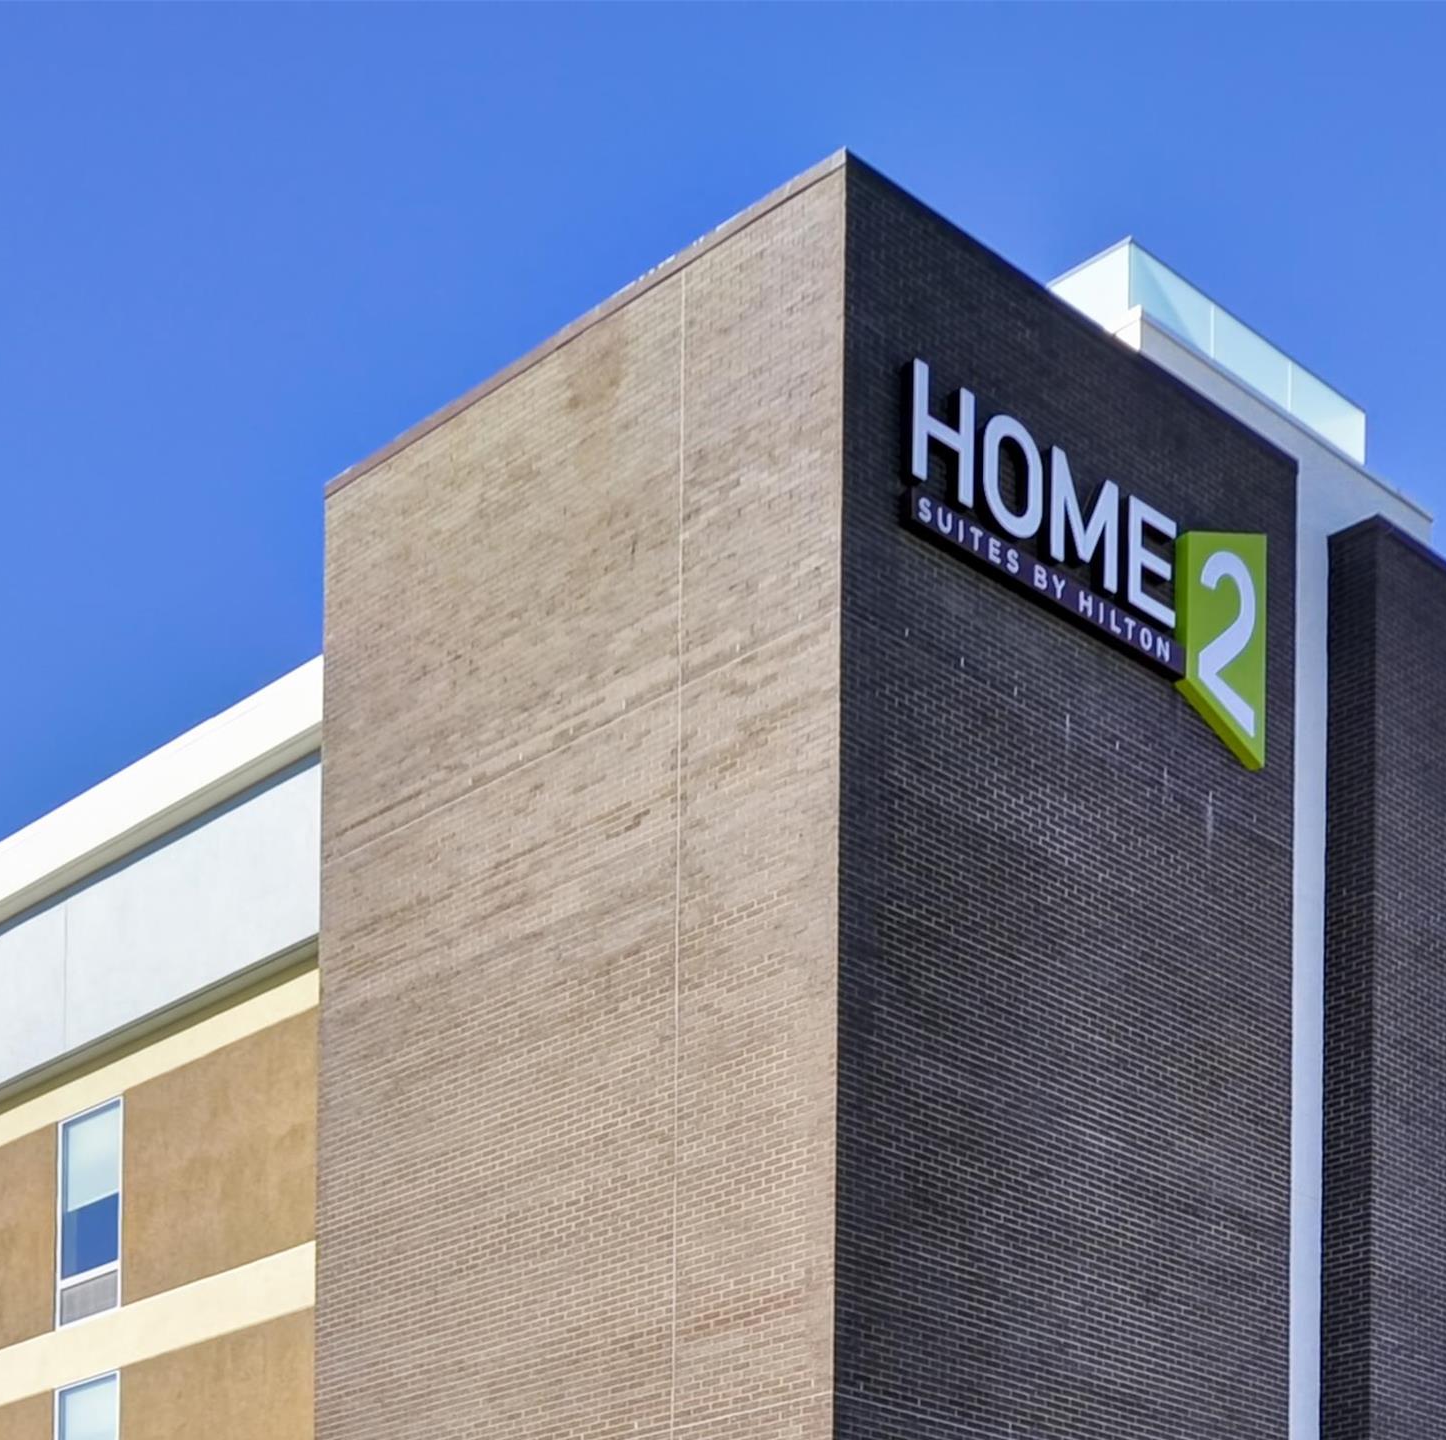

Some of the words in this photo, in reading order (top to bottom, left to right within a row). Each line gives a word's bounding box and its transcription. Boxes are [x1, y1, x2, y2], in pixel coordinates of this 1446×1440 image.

[912, 358, 1177, 628] HOME
[1198, 550, 1256, 738] 2
[917, 497, 1020, 574] SUITES
[1033, 564, 1066, 600] BY
[1078, 590, 1171, 662] HILTON
